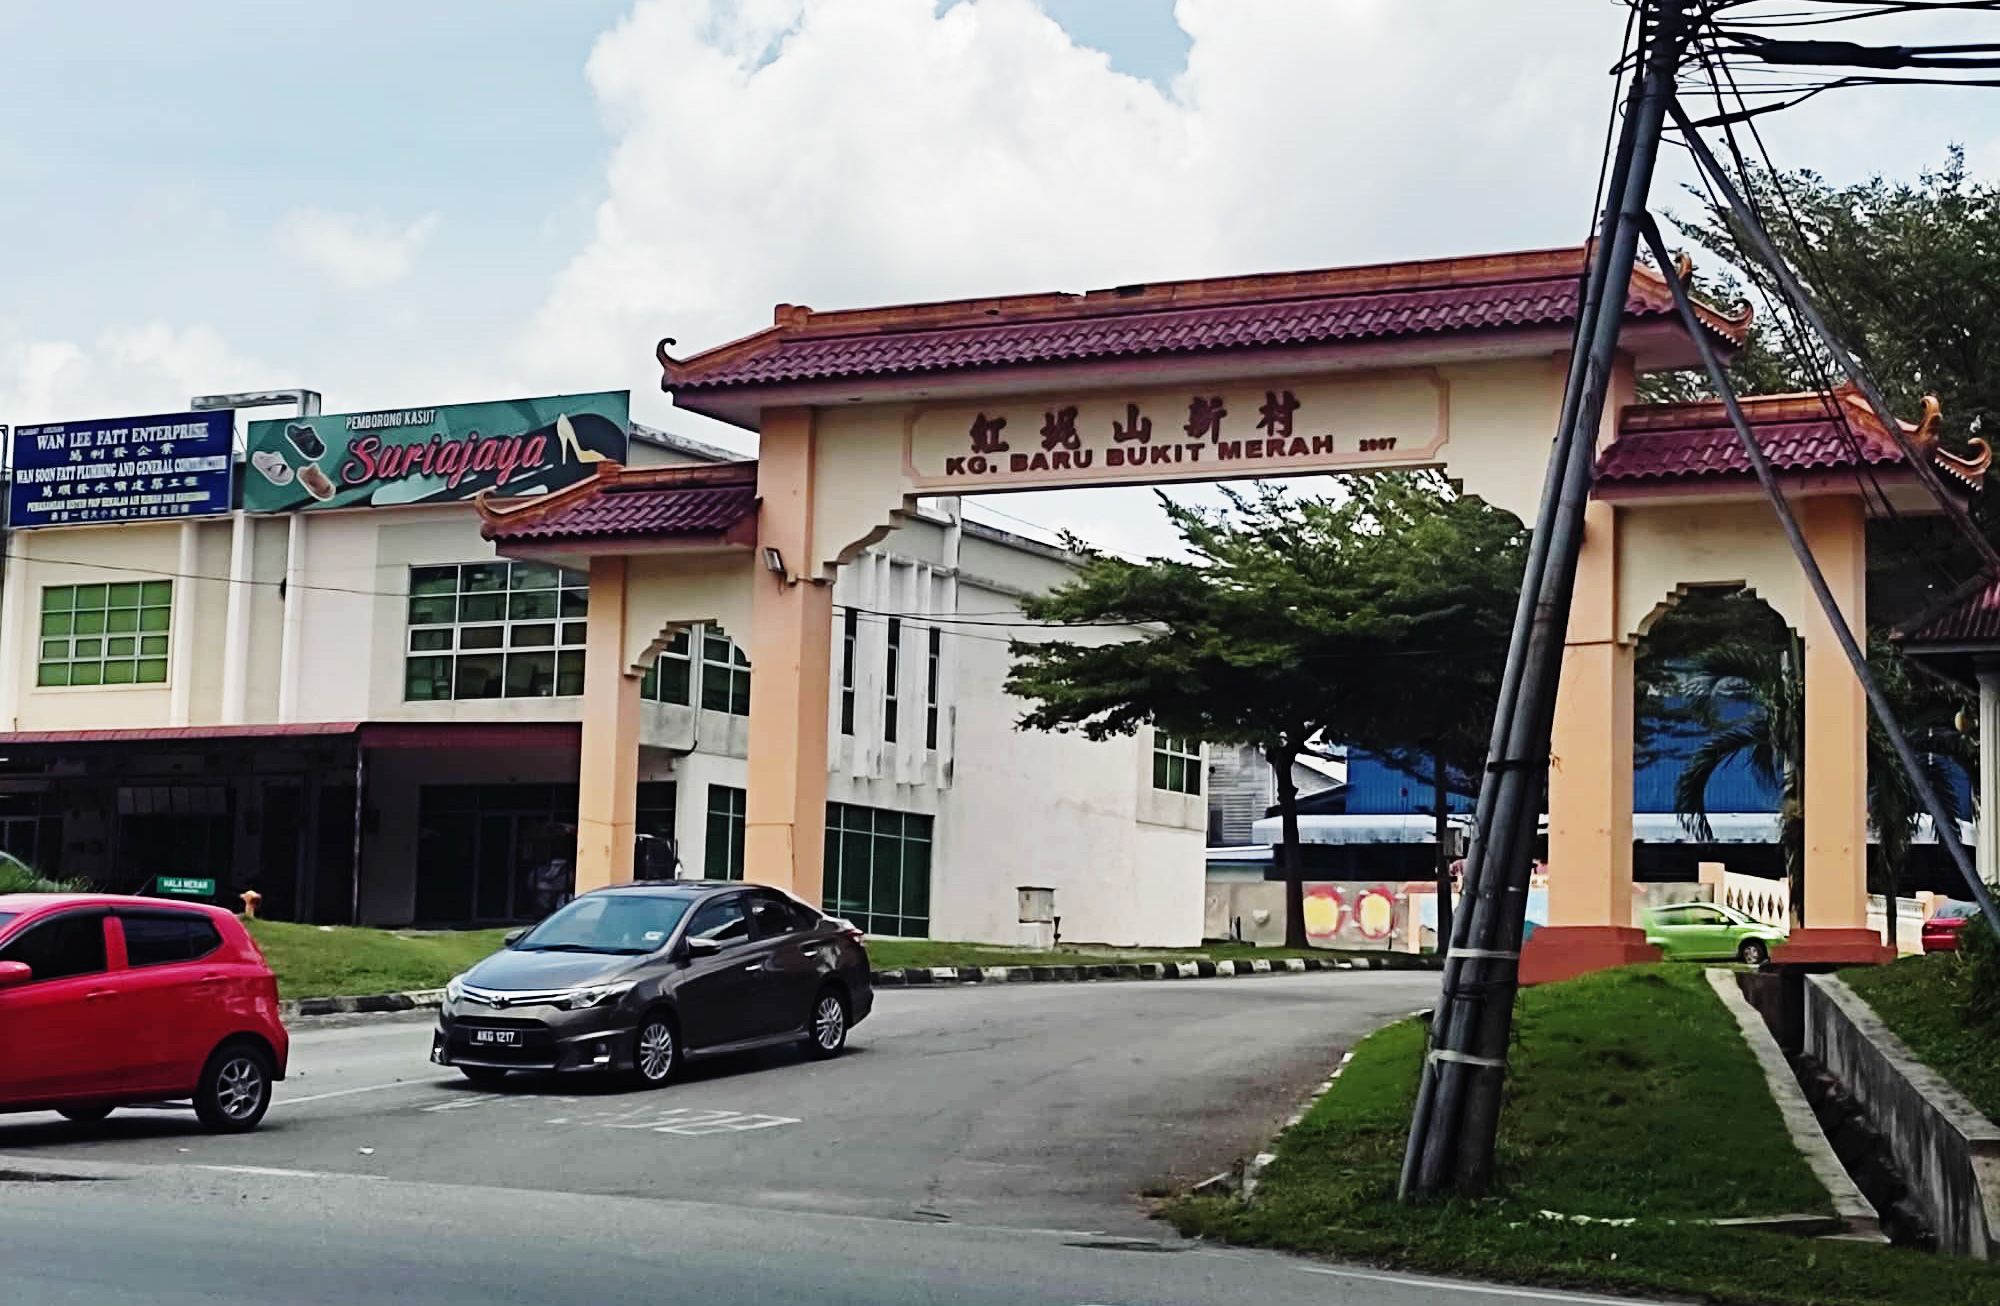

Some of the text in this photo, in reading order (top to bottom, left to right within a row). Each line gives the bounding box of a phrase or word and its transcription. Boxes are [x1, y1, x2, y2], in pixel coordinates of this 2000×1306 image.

[346, 410, 436, 429] PEMBORONG KASUT
[37, 422, 209, 450] WAN LEE FATT ENTERPRISE
[341, 432, 548, 489] Suriajaya
[946, 435, 1397, 477] KG. BARU BUKIT MERAH 2007
[16, 468, 35, 484] WAN
[35, 467, 56, 482] SOON
[56, 465, 77, 481] FATT
[117, 461, 135, 477] AND
[136, 458, 173, 476] GENERAL
[496, 1031, 515, 1043] 1217
